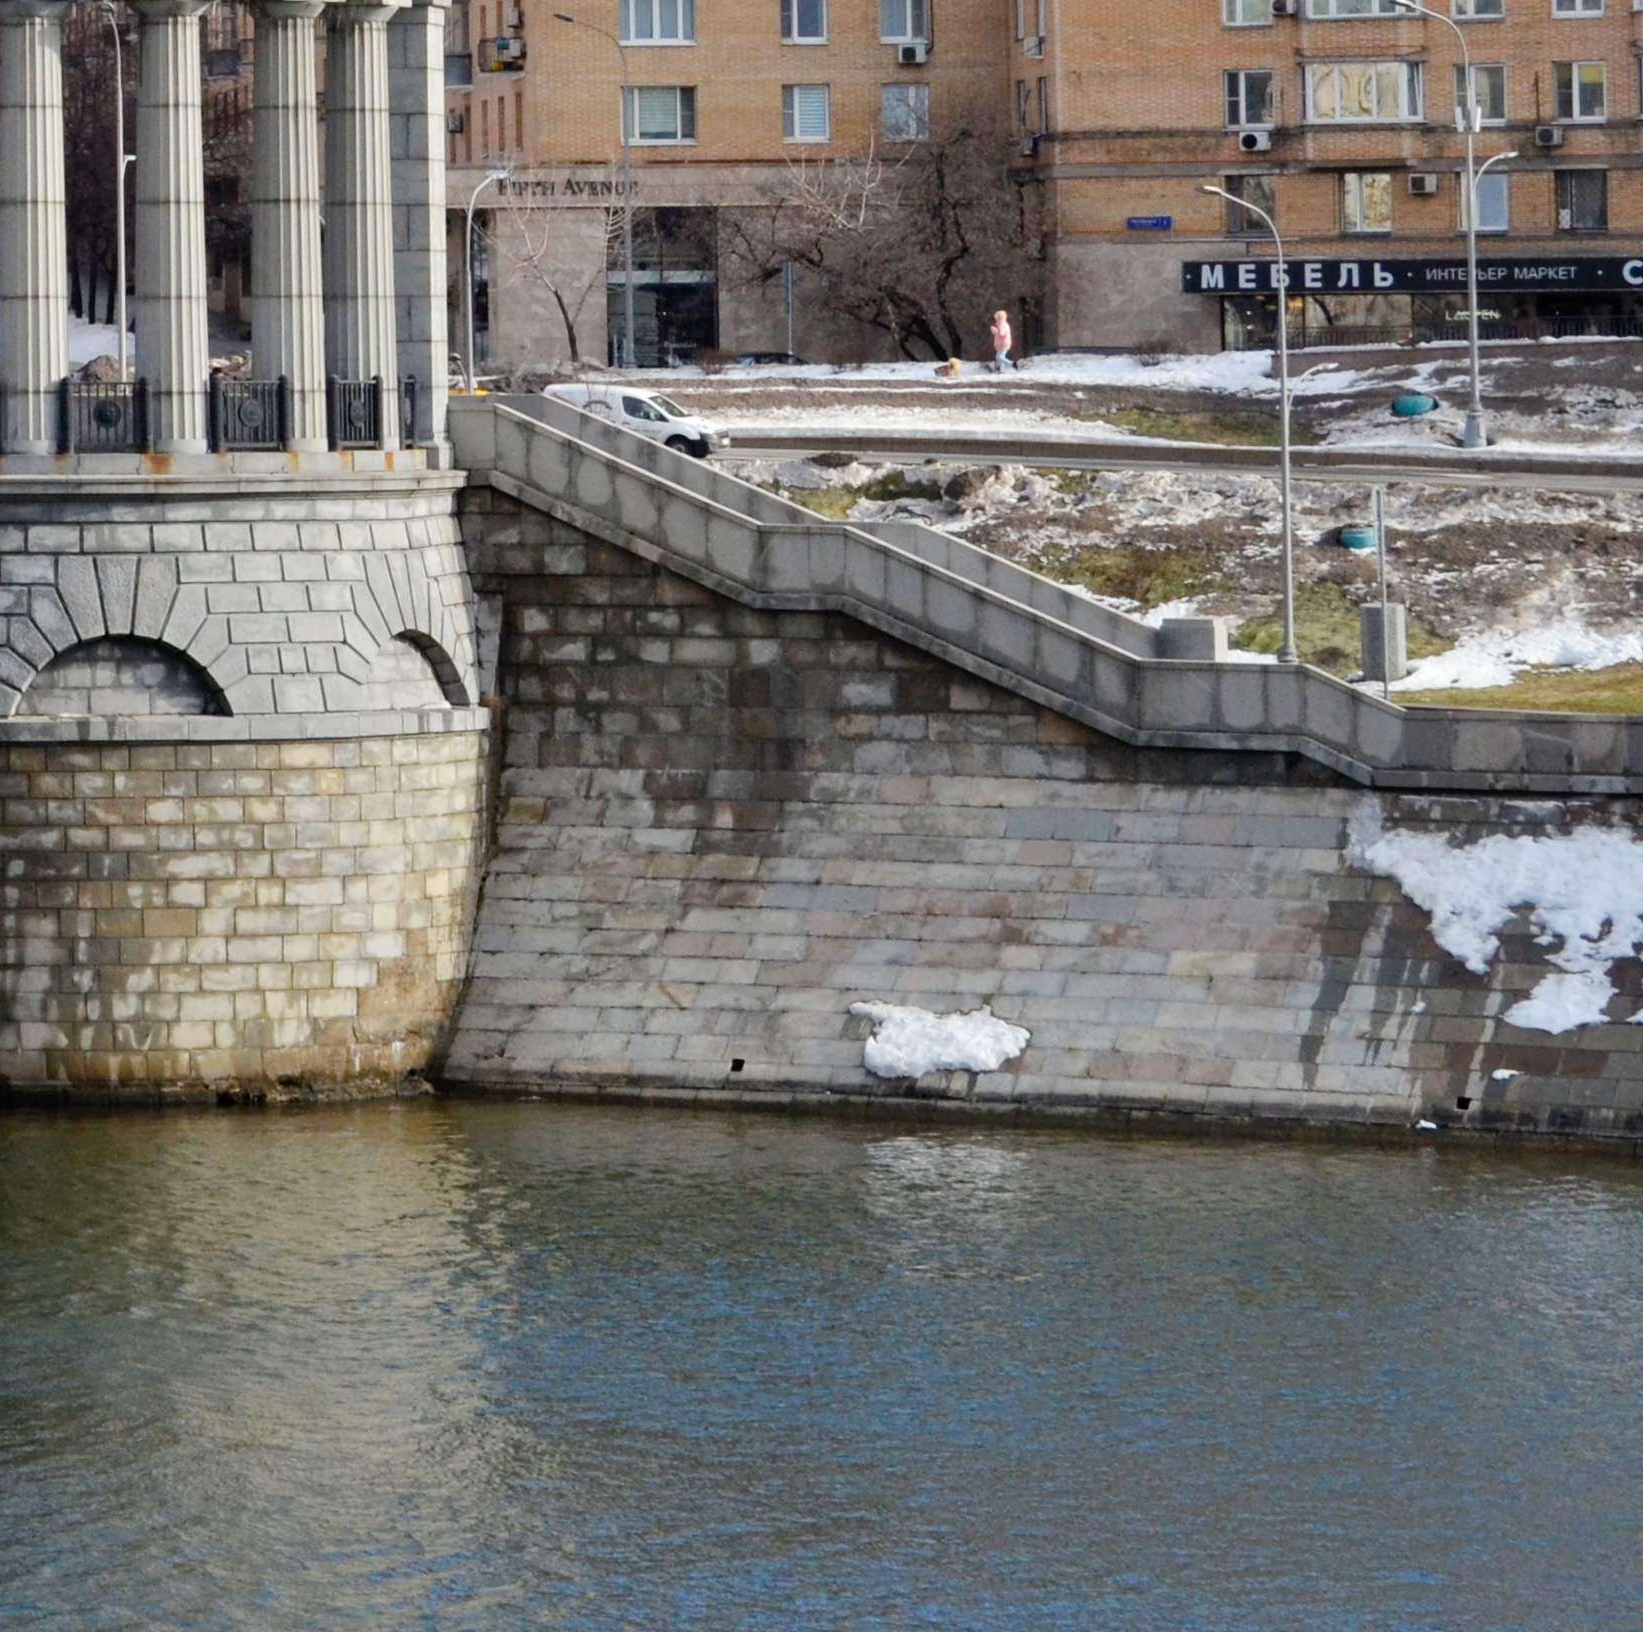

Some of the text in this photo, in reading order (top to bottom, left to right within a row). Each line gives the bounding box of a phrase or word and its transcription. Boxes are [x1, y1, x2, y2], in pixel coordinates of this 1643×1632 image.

[1201, 263, 1394, 288] МЕБЕЛЬ
[1426, 266, 1577, 280] ИНТЕЬЕР МАРКЕТ
